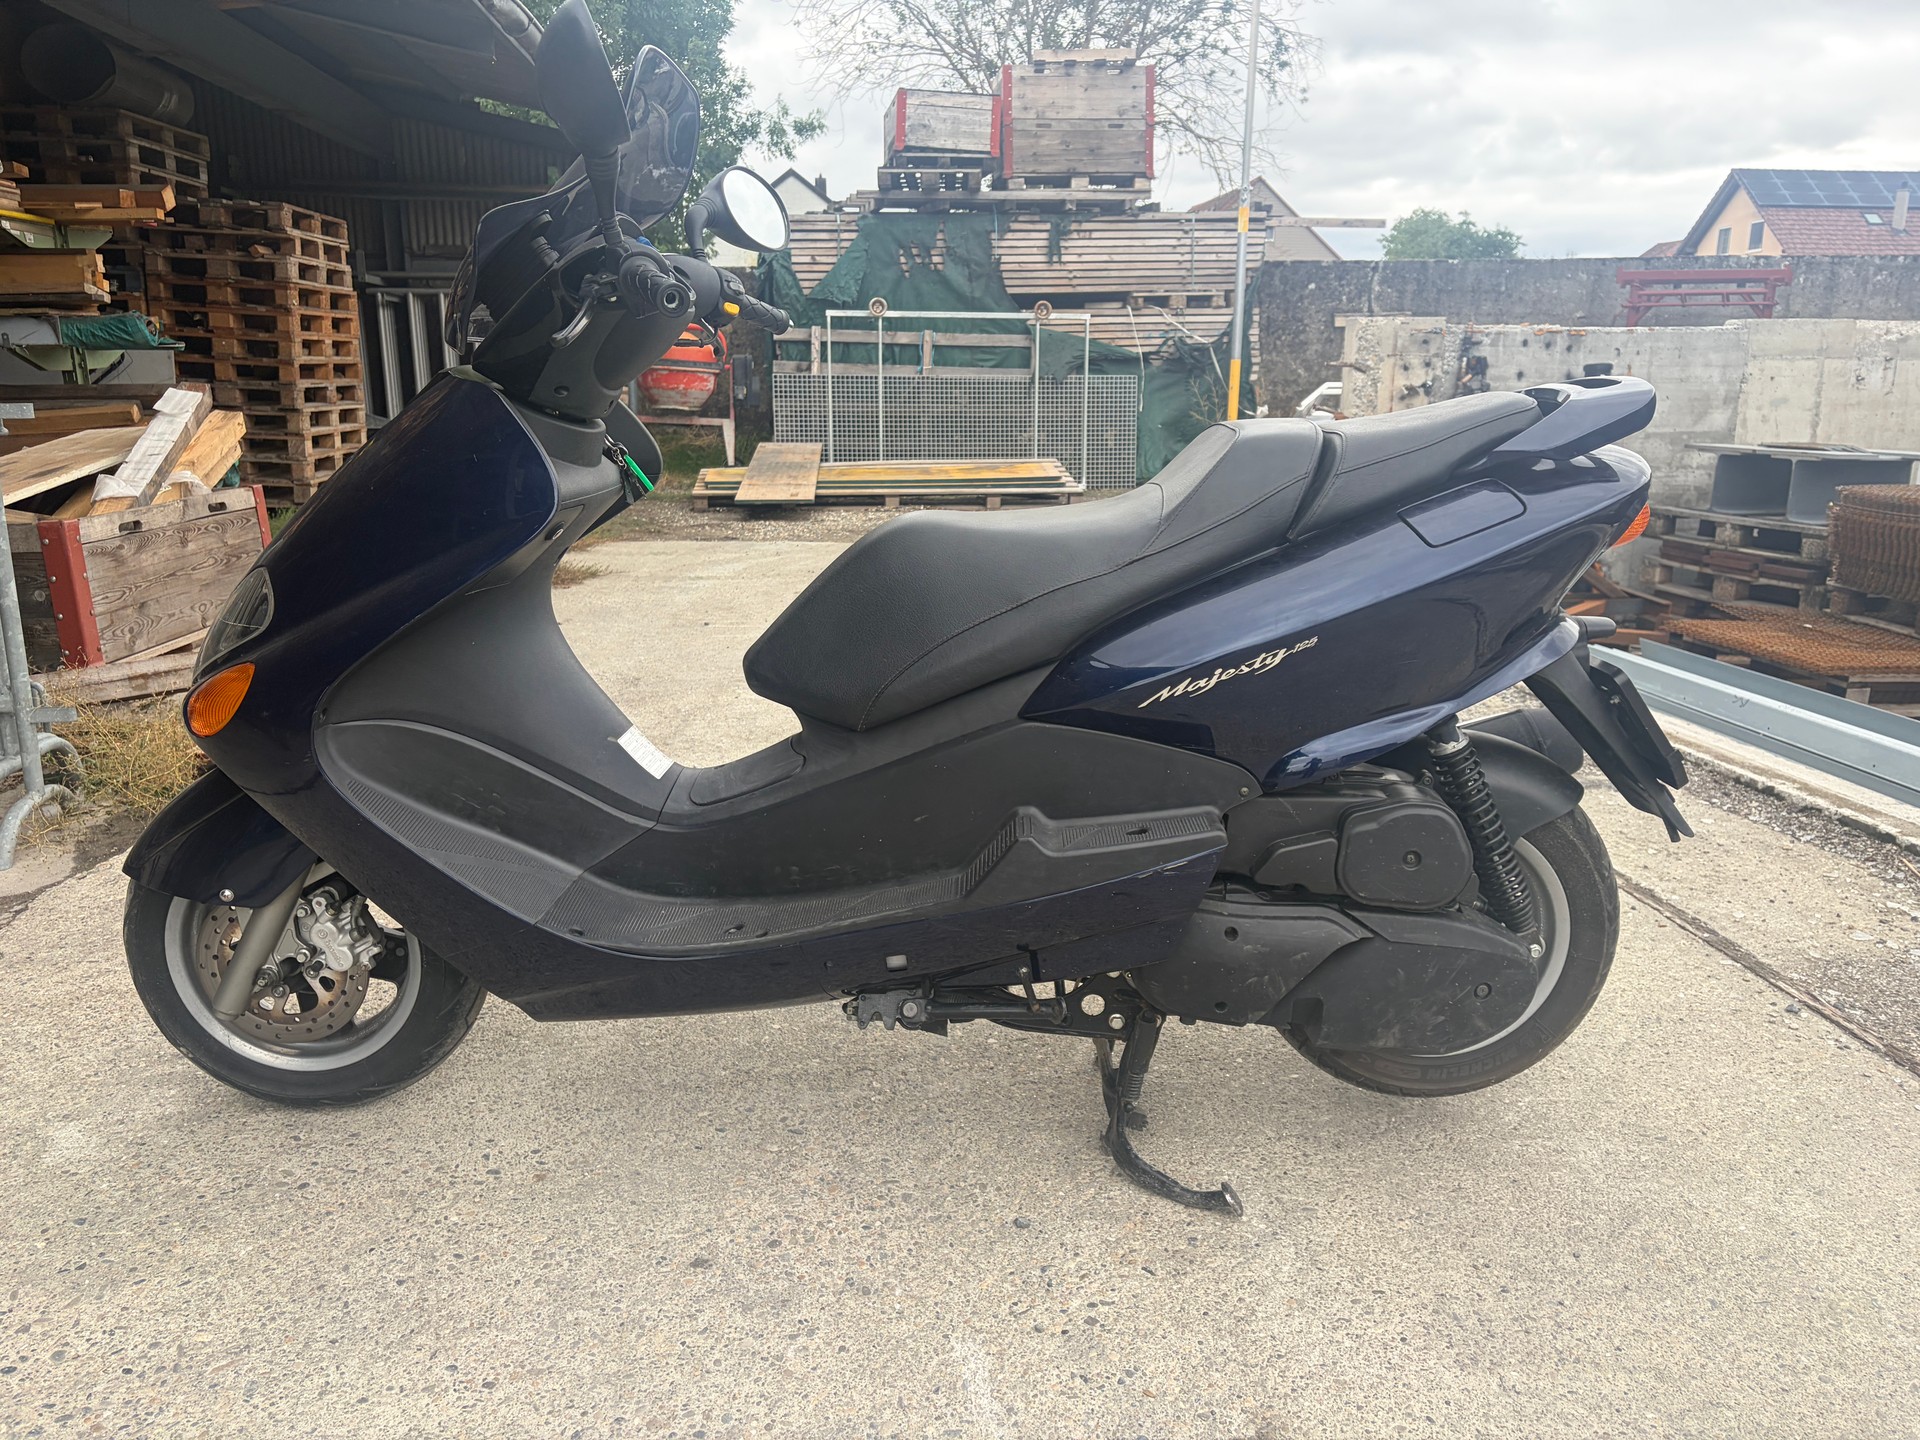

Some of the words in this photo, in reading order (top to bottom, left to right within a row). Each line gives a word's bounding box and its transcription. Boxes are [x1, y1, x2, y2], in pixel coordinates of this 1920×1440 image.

[1137, 648, 1294, 708] Majesty
[1293, 636, 1319, 653] 125
[1426, 1047, 1518, 1080] MICHELIN
